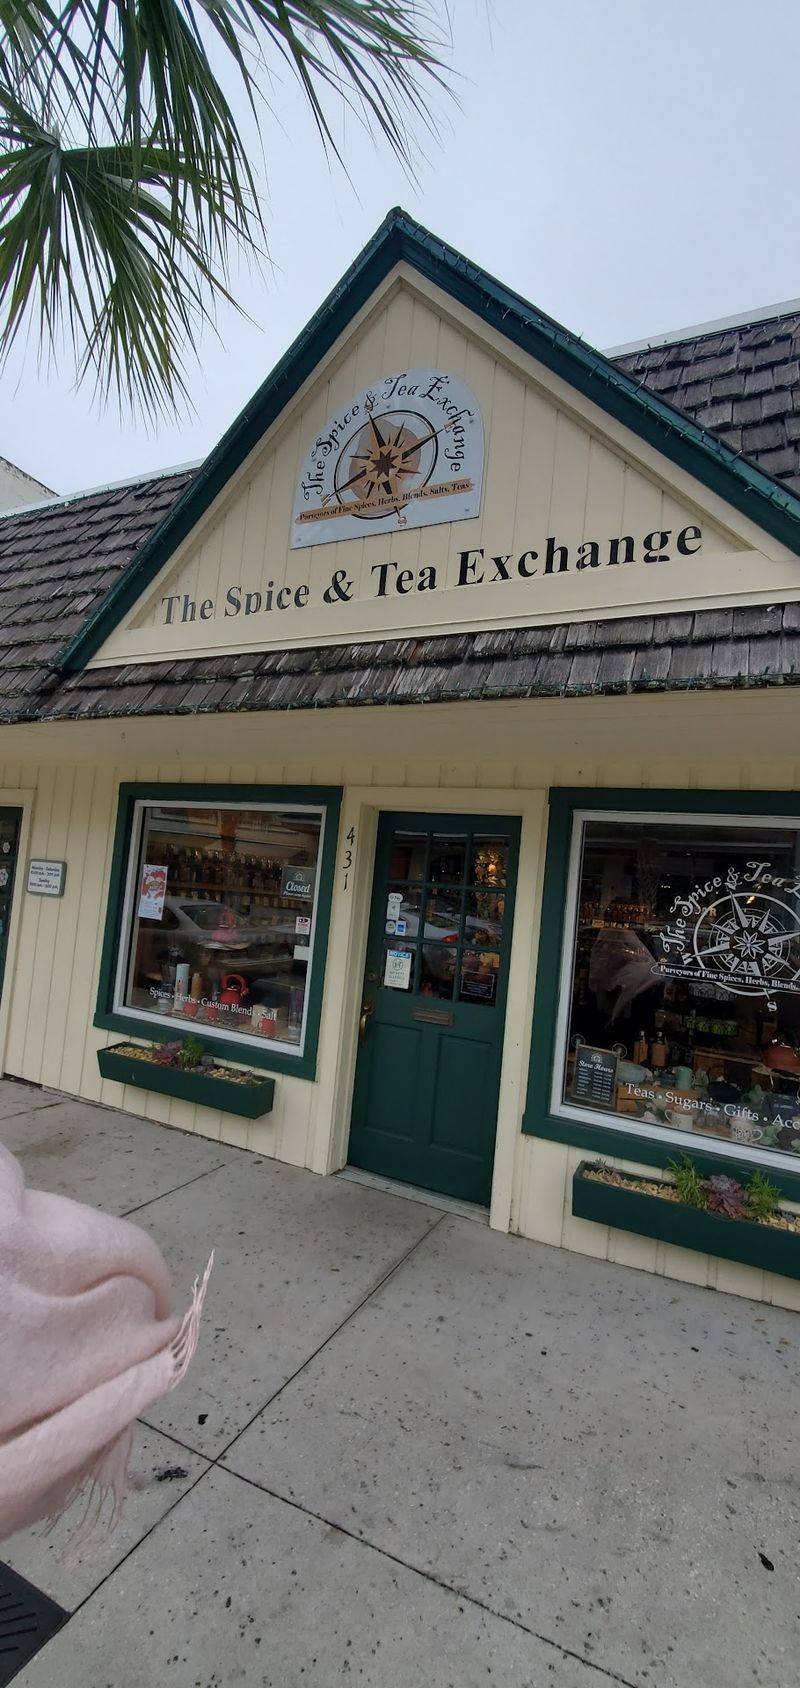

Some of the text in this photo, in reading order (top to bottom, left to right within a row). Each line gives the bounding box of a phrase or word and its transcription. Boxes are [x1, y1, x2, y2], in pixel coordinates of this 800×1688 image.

[301, 374, 475, 501] The Spice & Tea Exchange
[330, 508, 338, 517] of
[161, 524, 702, 625] The Spice & Tea Exchange
[285, 880, 311, 893] Closed
[726, 866, 742, 885] &
[743, 861, 786, 888] Tea
[669, 876, 722, 917] Spice
[660, 918, 687, 953] The
[660, 964, 693, 977] Purveyors
[701, 970, 718, 980] Fine
[718, 973, 744, 984] Spices,
[745, 976, 770, 988] Herbs,
[149, 986, 171, 999] Spices
[174, 993, 197, 1004] Herbs
[201, 997, 230, 1012] Custom
[578, 1060, 614, 1073] Store Hours
[625, 1082, 656, 1100] Teas
[665, 1092, 713, 1111] Sugars
[723, 1103, 759, 1121] Gifts
